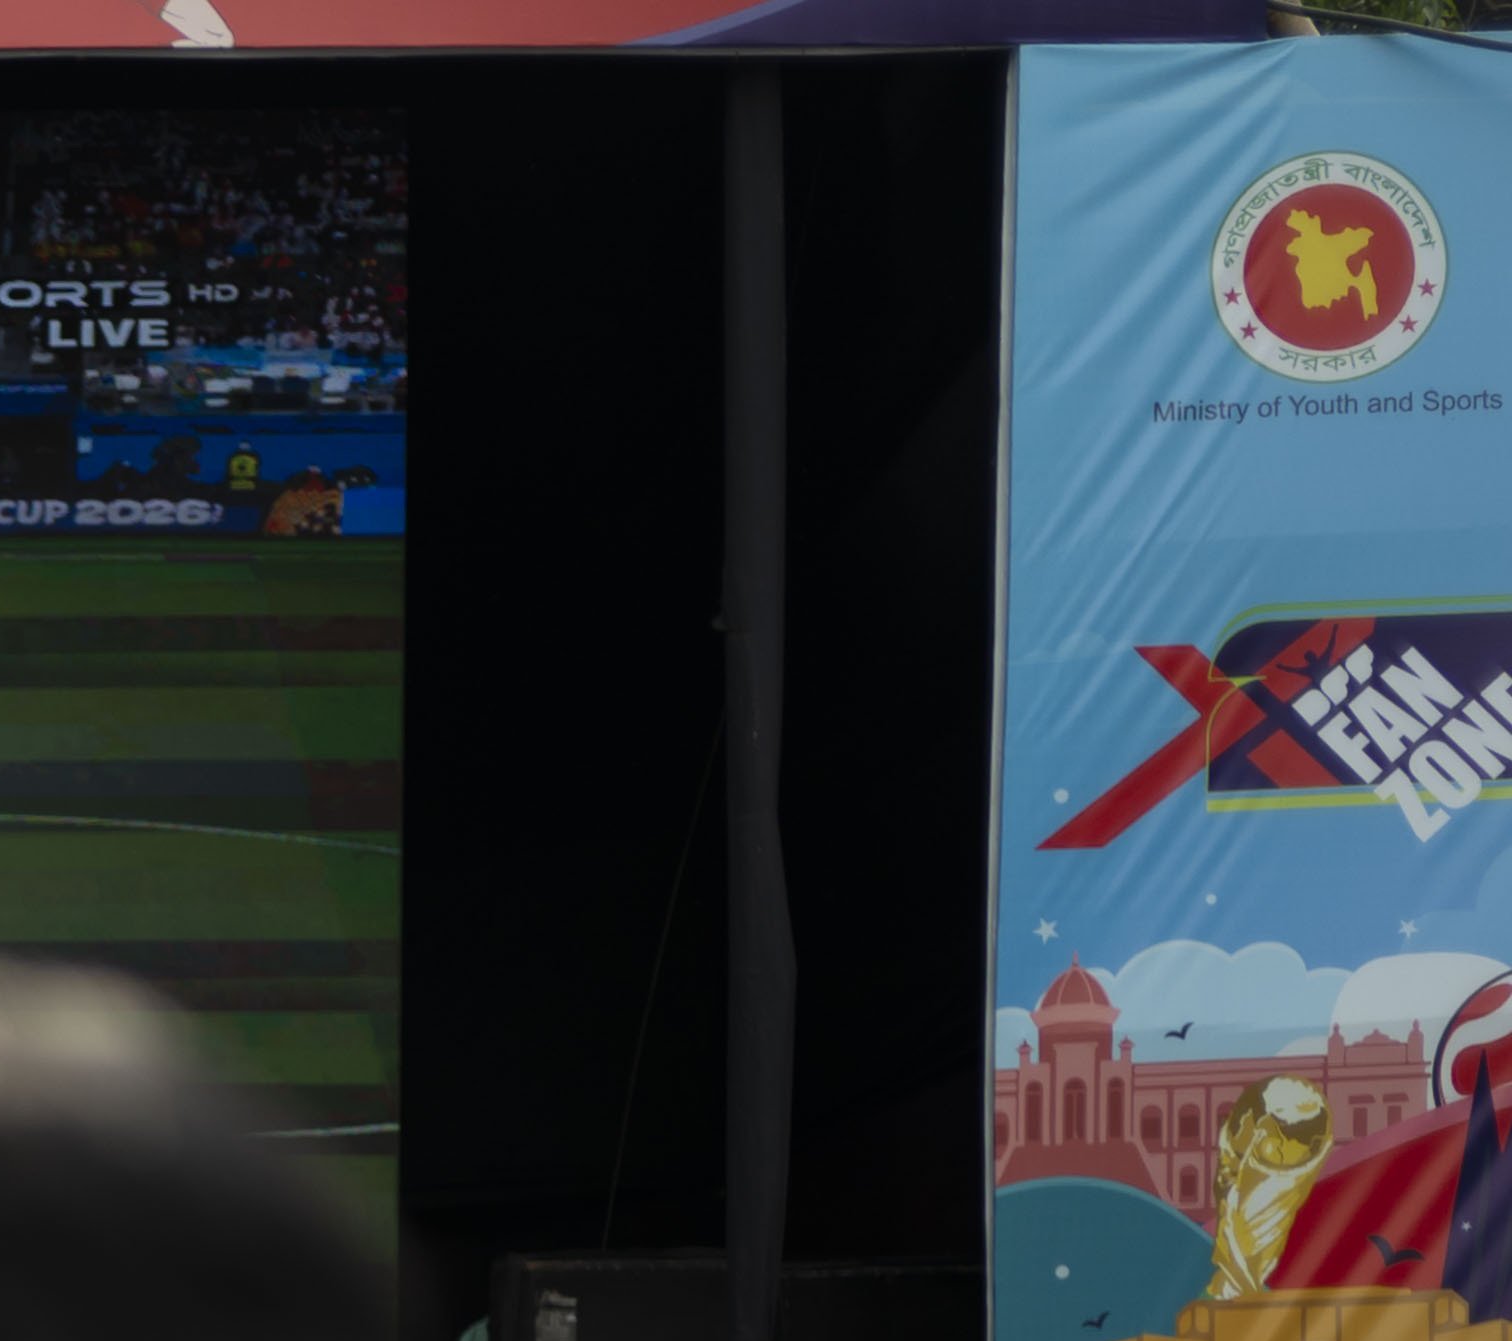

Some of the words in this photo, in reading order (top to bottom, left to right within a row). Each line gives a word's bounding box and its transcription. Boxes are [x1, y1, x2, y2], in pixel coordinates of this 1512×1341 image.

[187, 282, 239, 302] HD
[47, 320, 170, 349] LIVE
[1153, 399, 1249, 424] Ministry
[1257, 400, 1281, 418] of
[1288, 393, 1358, 417] Youth
[1367, 391, 1413, 413] and
[1423, 389, 1504, 416] Sports
[73, 499, 212, 526] 2026
[1316, 645, 1465, 785] FAN
